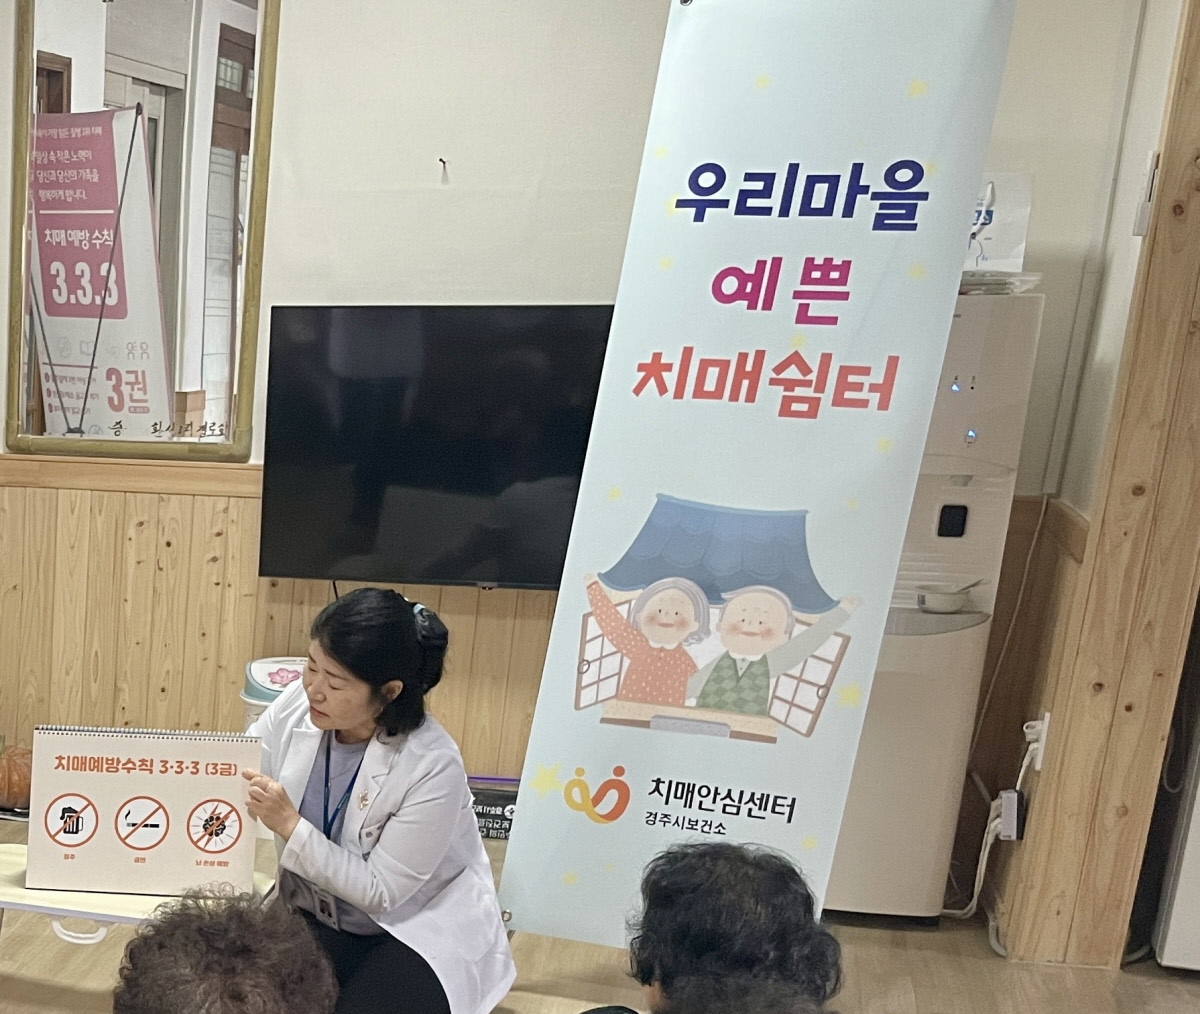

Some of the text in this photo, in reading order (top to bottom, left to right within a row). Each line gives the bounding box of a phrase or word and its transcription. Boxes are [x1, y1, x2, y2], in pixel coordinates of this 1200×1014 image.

[675, 160, 929, 231] 우리마을
[44, 228, 114, 250] 치매 예방 수칙
[50, 261, 119, 306] 3.3.3
[712, 257, 852, 325] 예쁜
[106, 367, 149, 413] 3권
[632, 346, 900, 419] 치매쉼터
[54, 755, 154, 775] 치매예방수칙
[644, 811, 727, 836] 경주시보건소
[648, 777, 797, 824] 치매안심센터
